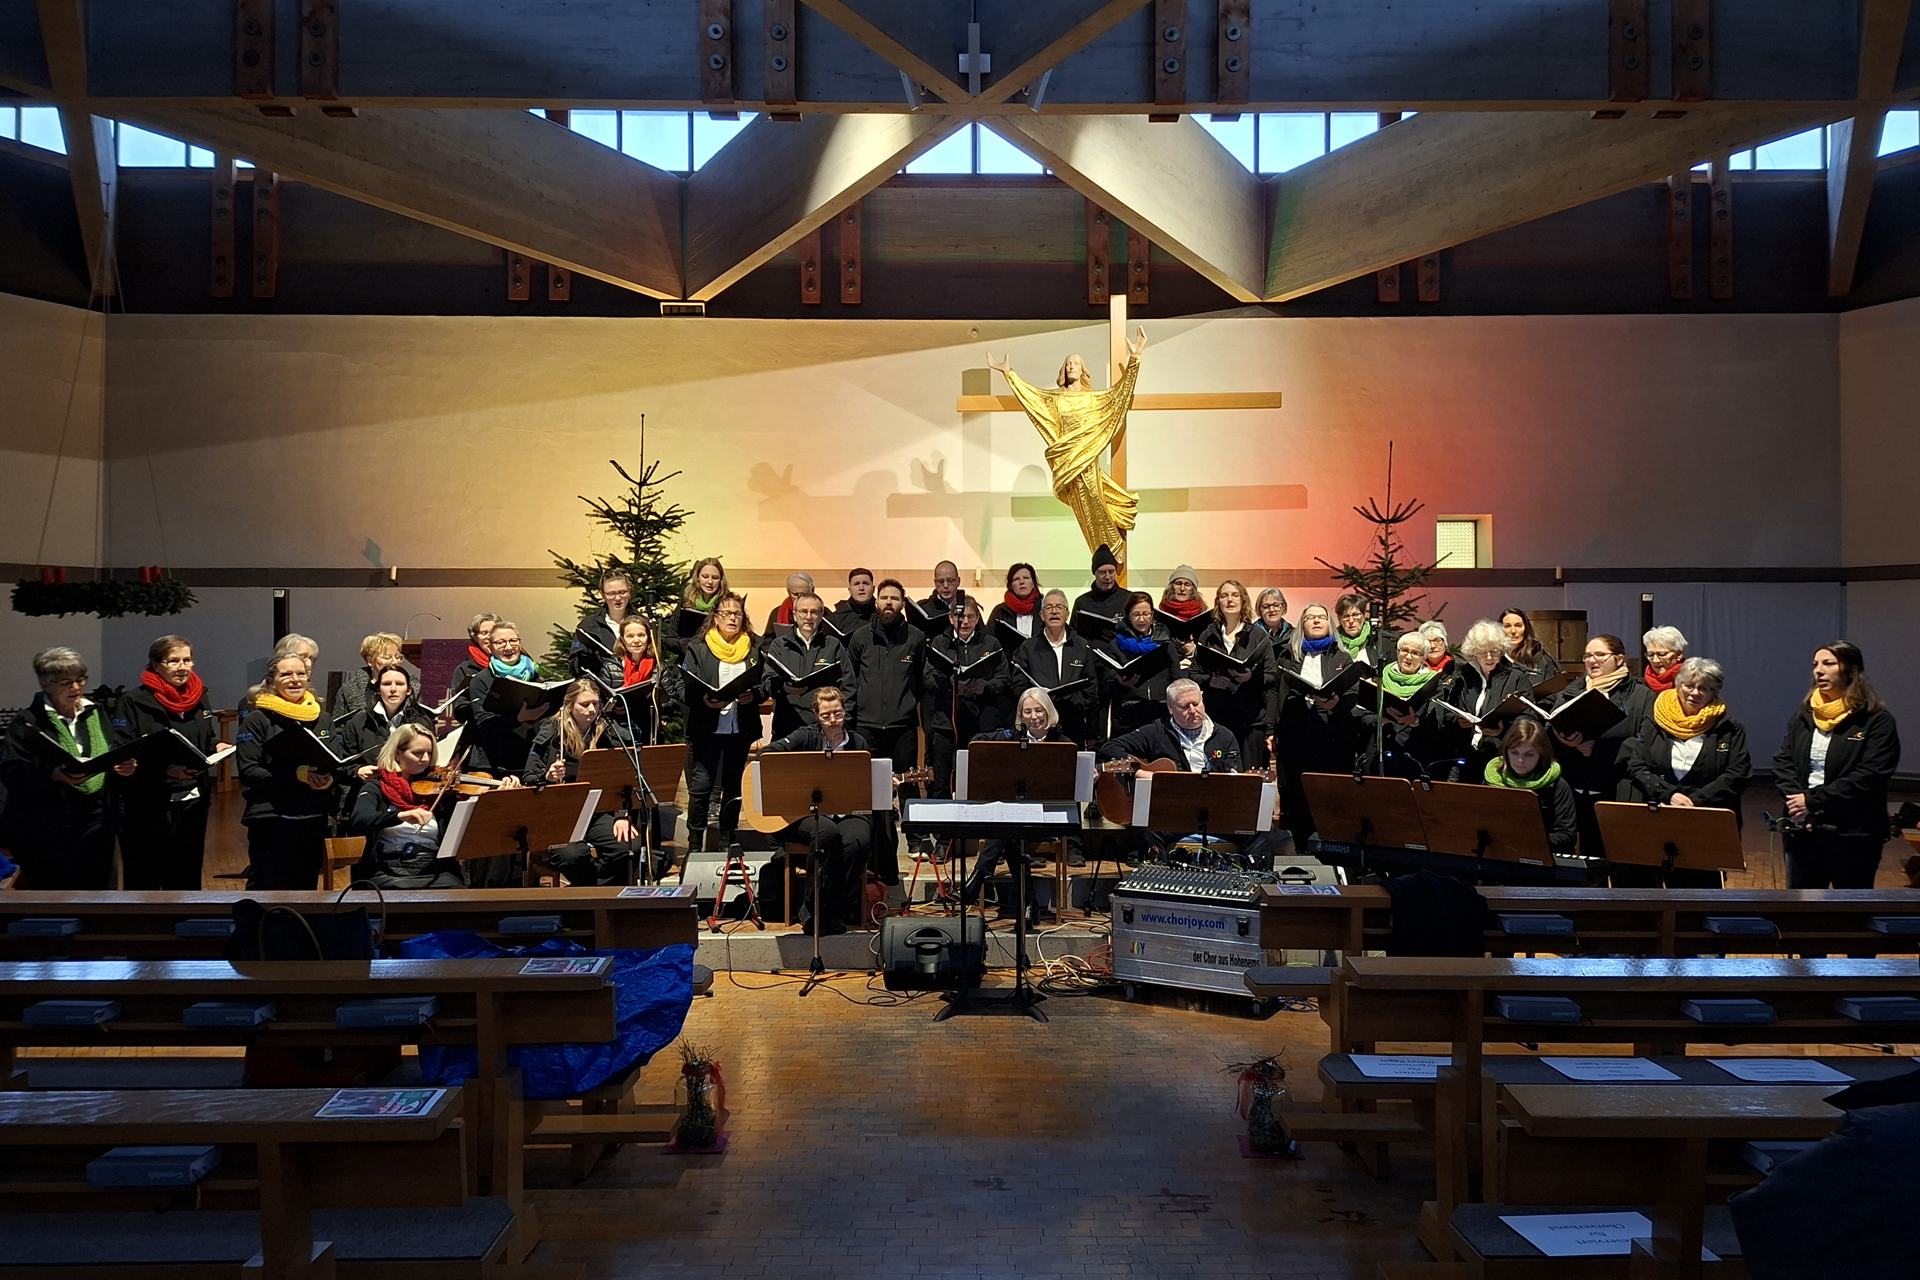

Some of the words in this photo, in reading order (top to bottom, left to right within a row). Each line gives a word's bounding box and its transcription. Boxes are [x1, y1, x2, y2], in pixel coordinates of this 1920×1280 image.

[1324, 843, 1350, 854] YAMAHA
[1141, 912, 1225, 930] www.chorjoy.com
[1129, 941, 1146, 955] JOY
[1192, 950, 1202, 963] der
[1203, 951, 1217, 964] Chor
[1218, 954, 1229, 966] aus
[1547, 1223, 1626, 1232] Chorverband
[1587, 1230, 1607, 1238] für
[1575, 1238, 1632, 1246] eserviert
